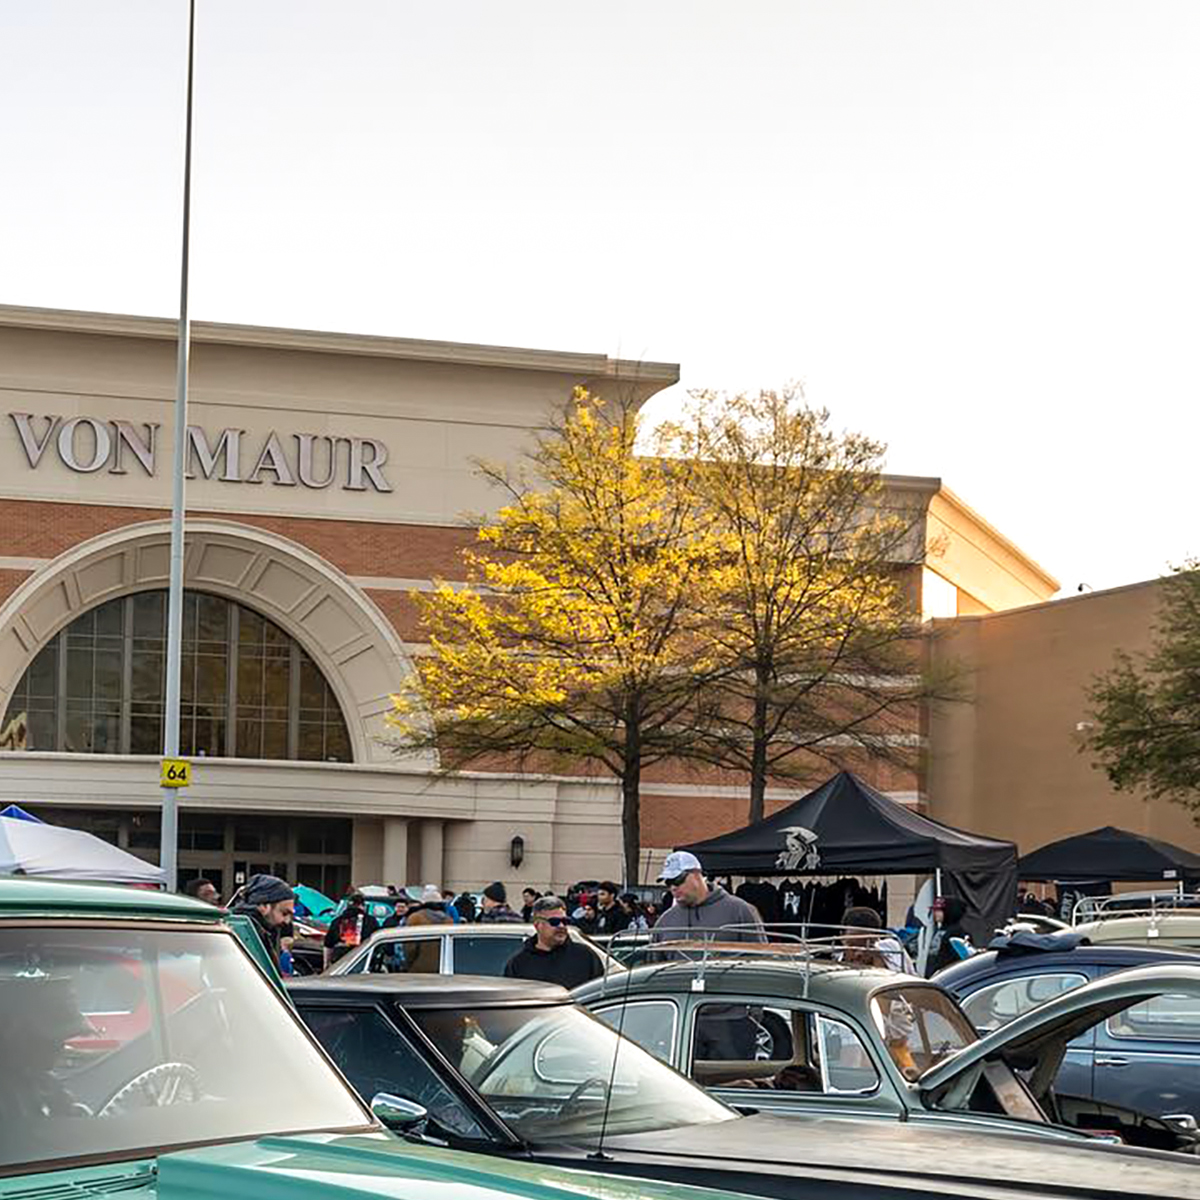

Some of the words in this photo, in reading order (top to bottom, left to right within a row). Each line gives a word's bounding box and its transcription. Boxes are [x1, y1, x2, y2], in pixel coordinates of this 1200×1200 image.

[8, 412, 161, 477] VON
[183, 425, 394, 493] MAUR
[167, 764, 187, 780] 64
